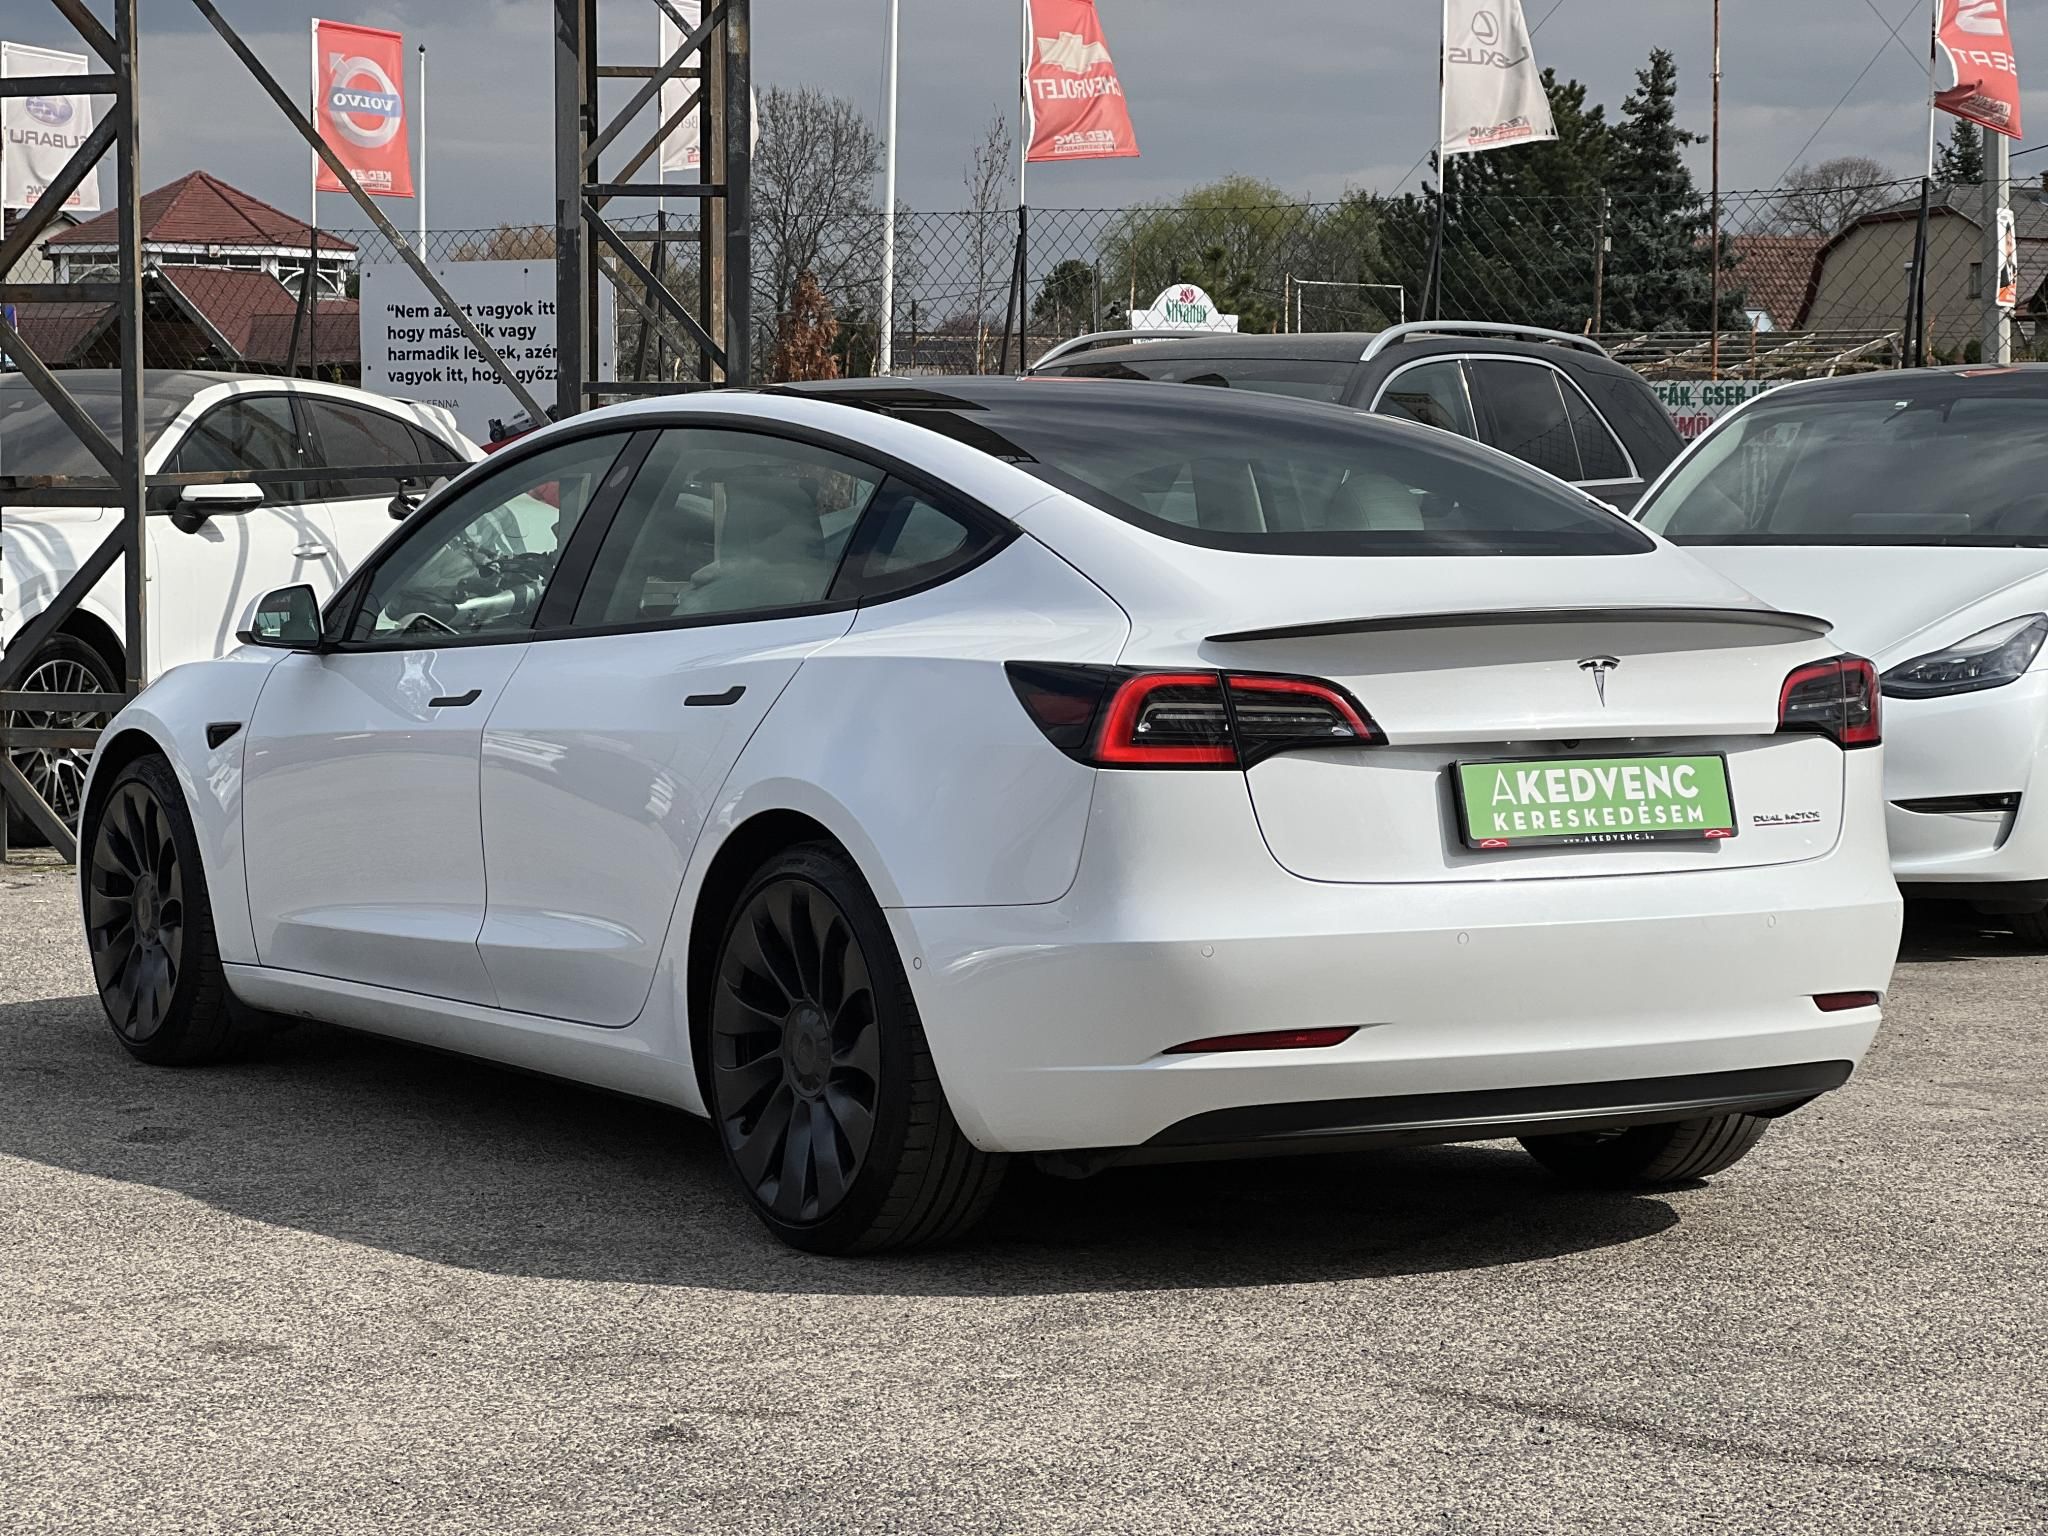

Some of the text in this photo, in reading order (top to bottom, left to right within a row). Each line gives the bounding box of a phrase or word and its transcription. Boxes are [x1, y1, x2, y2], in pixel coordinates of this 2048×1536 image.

[434, 303, 473, 318] azt
[477, 301, 533, 320] vagyok
[1166, 298, 1208, 324] Silvanus
[387, 323, 537, 342] hogy másoik vagy
[387, 345, 460, 361] harmadik
[464, 345, 521, 363] legek,
[387, 367, 442, 386] vagyok
[446, 366, 468, 384] itt,
[472, 366, 507, 385] hog
[1651, 382, 1697, 409] FÁK,
[1493, 801, 1704, 832] KERESKEDÉSEM
[1753, 811, 1820, 823] DUAL MOTOR
